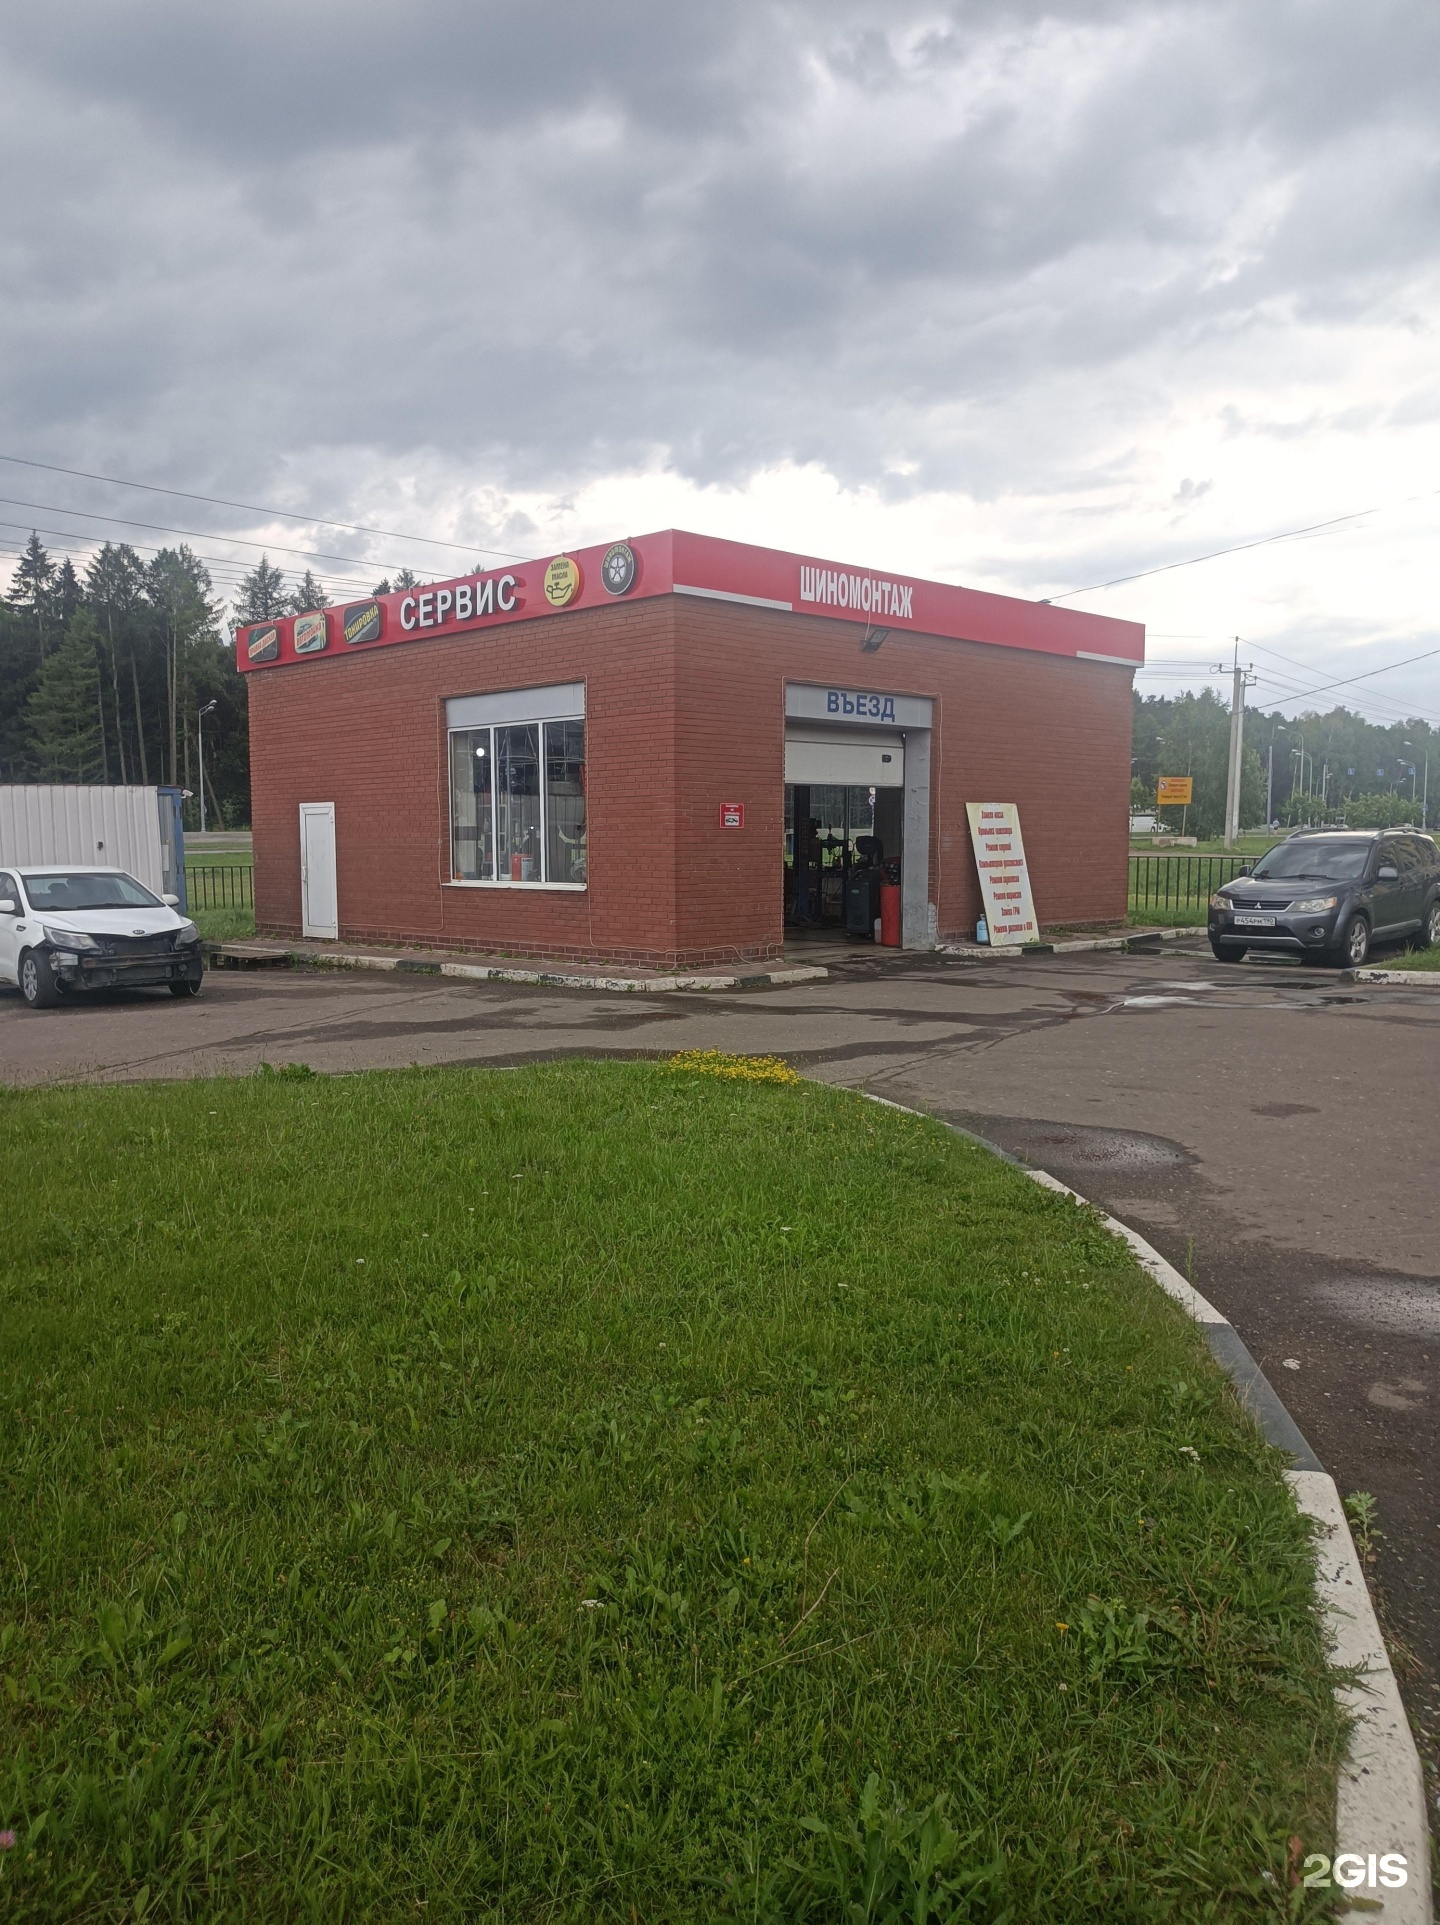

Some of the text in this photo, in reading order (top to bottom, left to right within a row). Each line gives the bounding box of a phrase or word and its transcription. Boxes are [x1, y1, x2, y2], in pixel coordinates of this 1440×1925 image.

[550, 561, 569, 571] ЗАМЕНА
[551, 571, 568, 581] МАСЛА
[400, 574, 516, 631] СЕРВИС
[800, 565, 913, 618] ШИНОМОНТАЖ
[344, 604, 379, 641] ТОНИРОВКА
[826, 691, 896, 723] ВЪЕЗД
